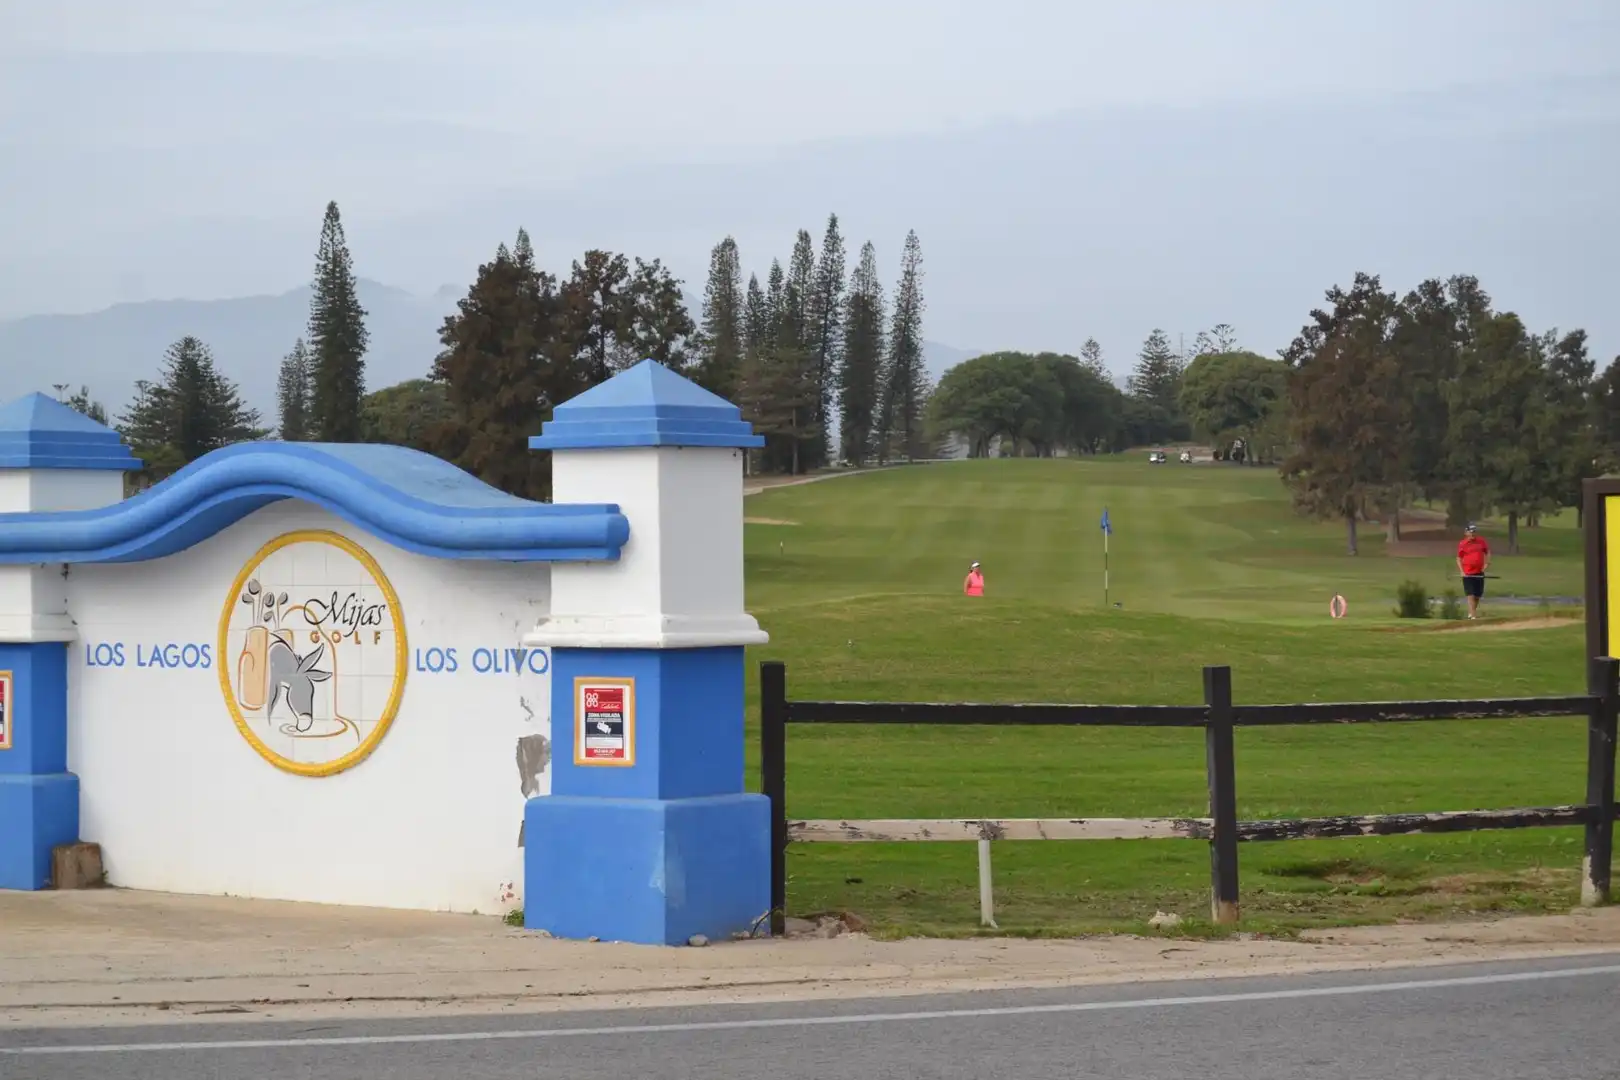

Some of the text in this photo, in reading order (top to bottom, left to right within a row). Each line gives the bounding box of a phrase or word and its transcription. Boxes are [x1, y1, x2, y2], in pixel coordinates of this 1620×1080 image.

[303, 590, 386, 638] Mijas
[310, 630, 381, 645] GOLF
[86, 642, 212, 668] LOS LAGOS
[416, 647, 458, 673] LOS
